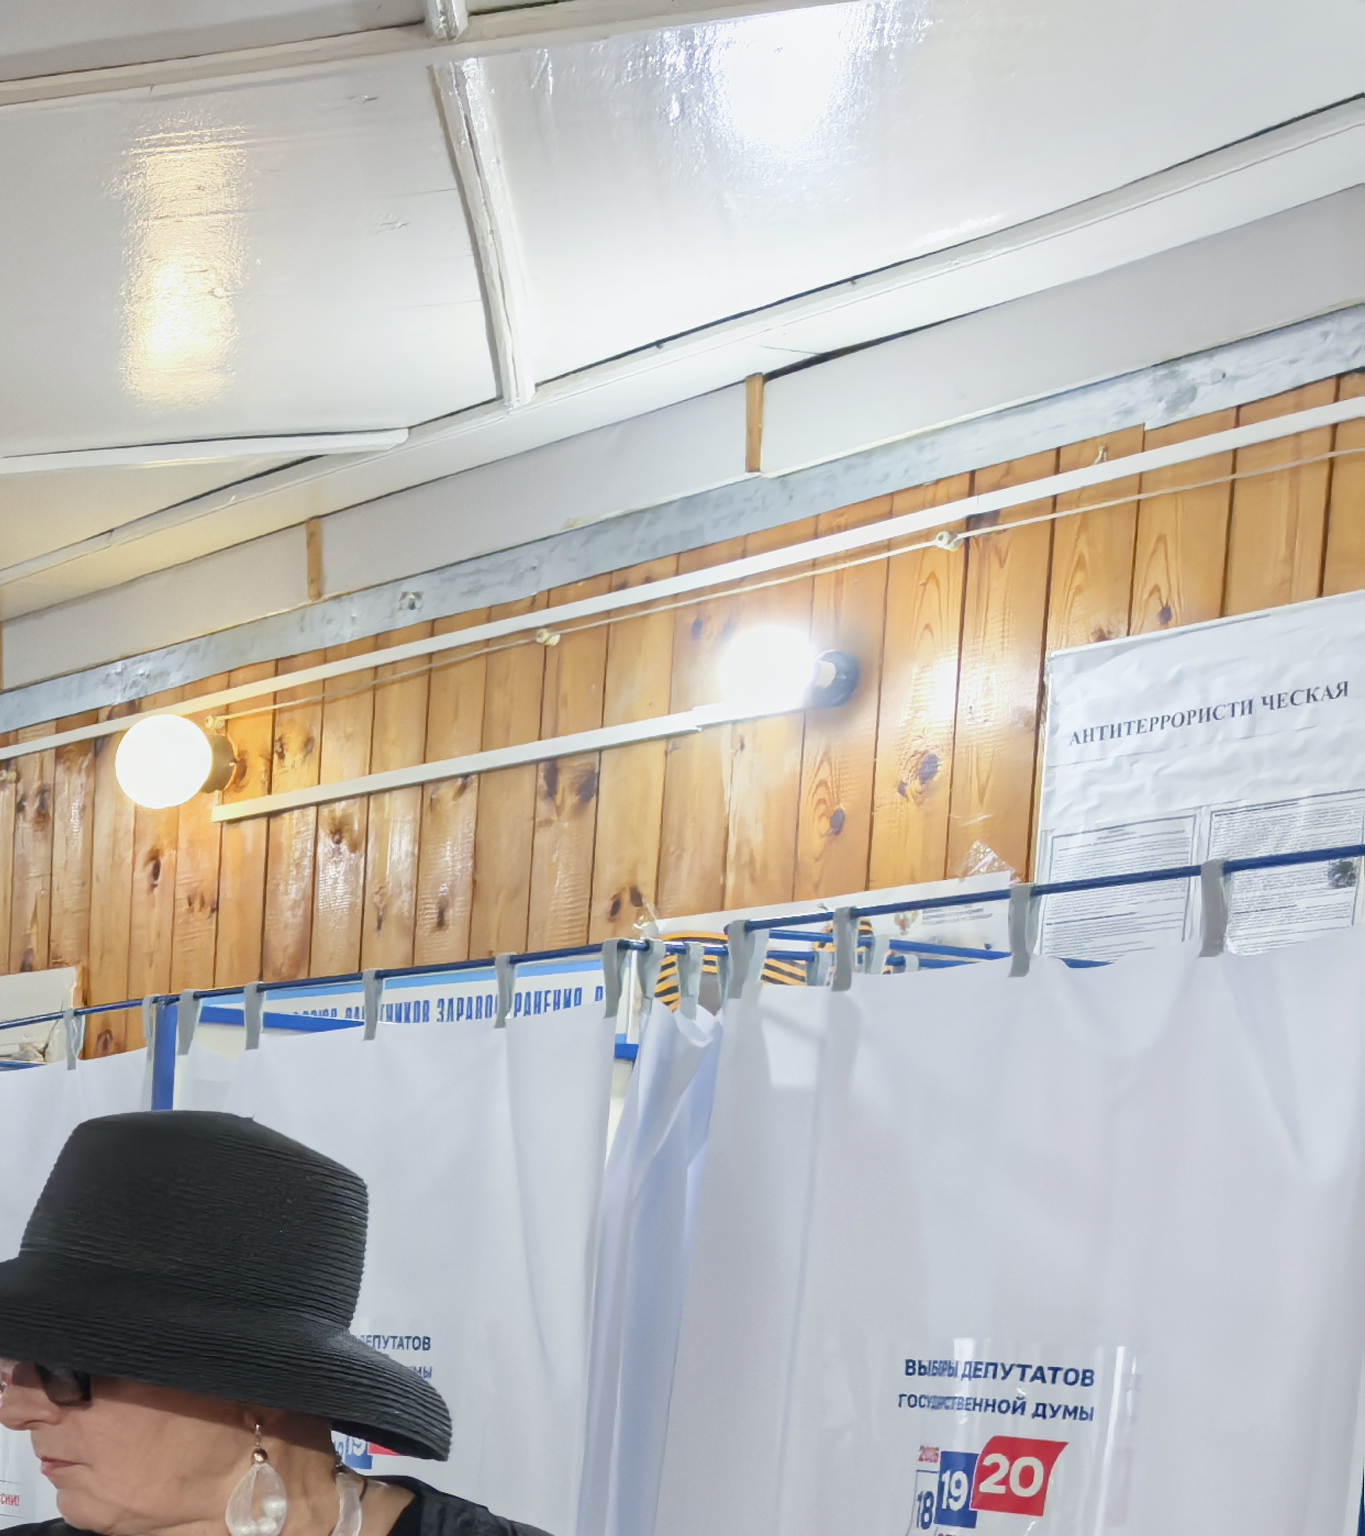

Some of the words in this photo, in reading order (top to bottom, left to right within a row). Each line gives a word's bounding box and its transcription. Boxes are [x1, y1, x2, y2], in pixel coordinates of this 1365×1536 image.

[961, 1361, 1095, 1387] ДЕПУТАТОВ
[1031, 1402, 1094, 1422] ДУМЫ
[916, 1490, 935, 1530] 18
[941, 1470, 968, 1511] 19
[979, 1453, 1045, 1498] 20
